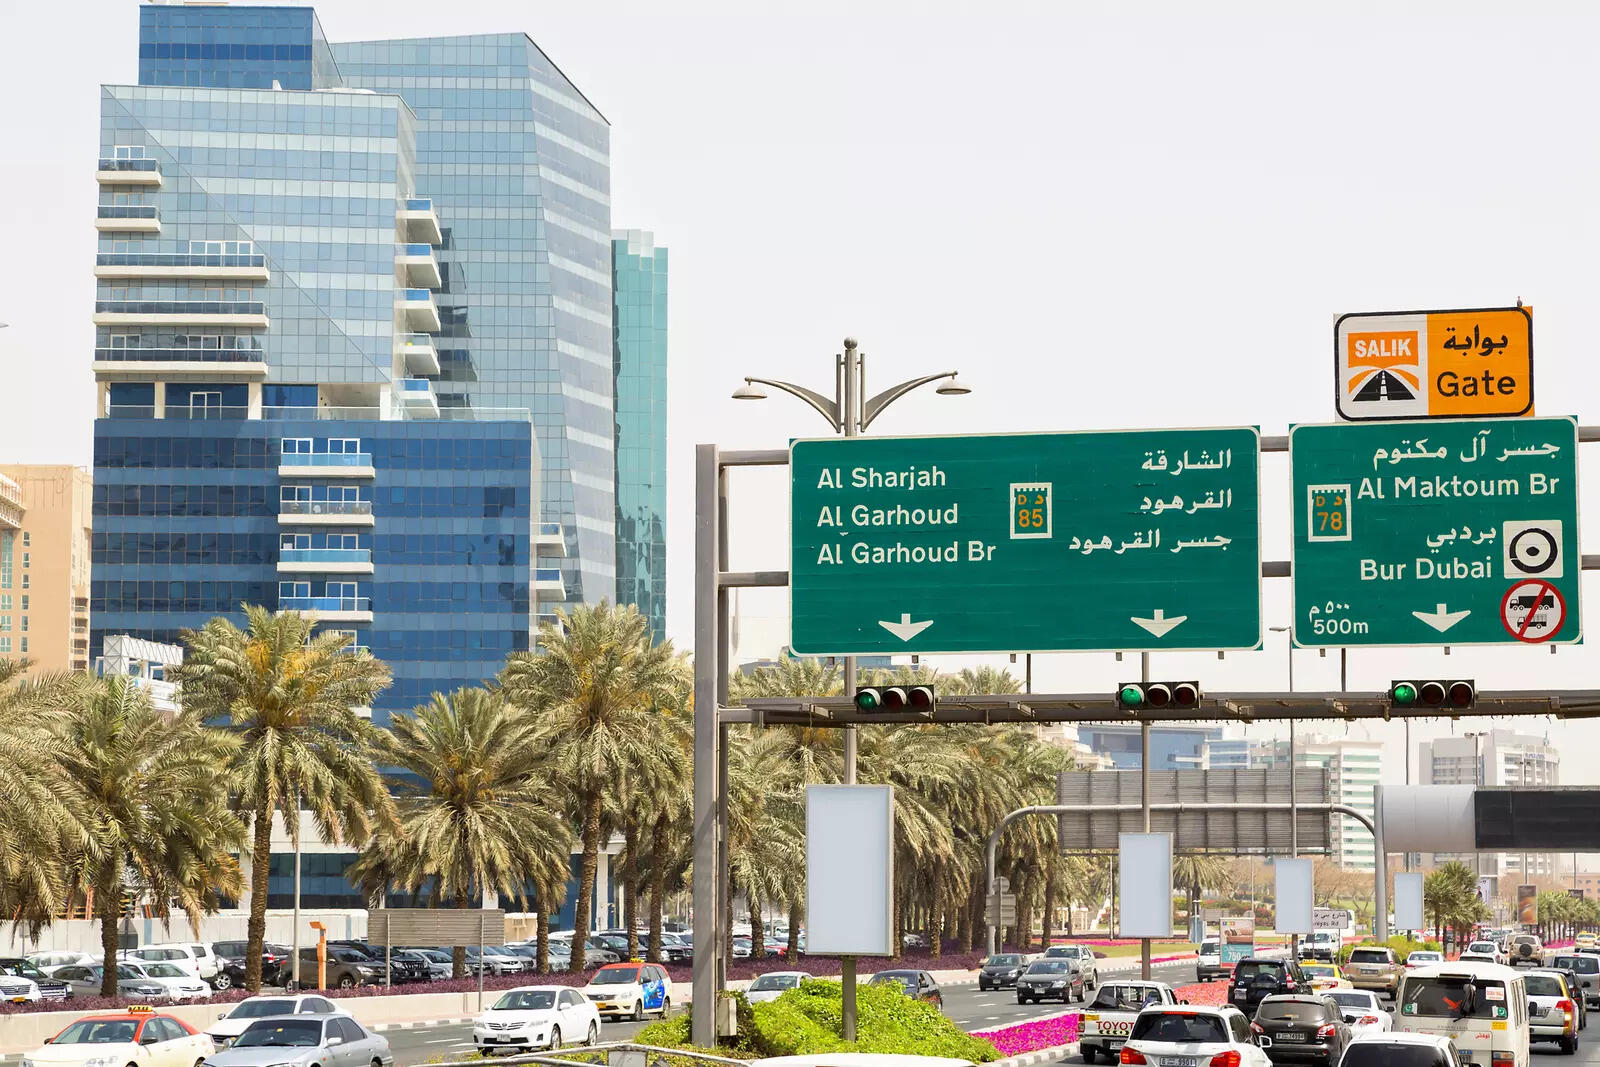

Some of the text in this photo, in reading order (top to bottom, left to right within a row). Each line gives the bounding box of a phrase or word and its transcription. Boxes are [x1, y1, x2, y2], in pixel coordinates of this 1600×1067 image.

[1354, 337, 1412, 358] SALIK
[1443, 324, 1509, 356] بوابة
[1437, 370, 1516, 397] Gate
[1141, 448, 1232, 476] الشارقة
[1374, 439, 1448, 471] مكتوم
[1496, 443, 1561, 463] جسر
[817, 466, 946, 491] Al Sharjah
[1357, 473, 1560, 500] Al Maktoum Br
[1017, 494, 1027, 505] D
[1140, 488, 1232, 514] القرهود
[1315, 495, 1325, 507] D
[817, 504, 958, 527] Al Garhoud
[1018, 508, 1043, 528] 85
[1317, 511, 1343, 531] 78
[817, 540, 997, 565] Al Garhoud Br
[1069, 529, 1232, 555] جسر القرهود
[1360, 556, 1492, 581] Bur Dubai
[1313, 618, 1369, 635] 500m
[1096, 1020, 1135, 1031] TOYOT
